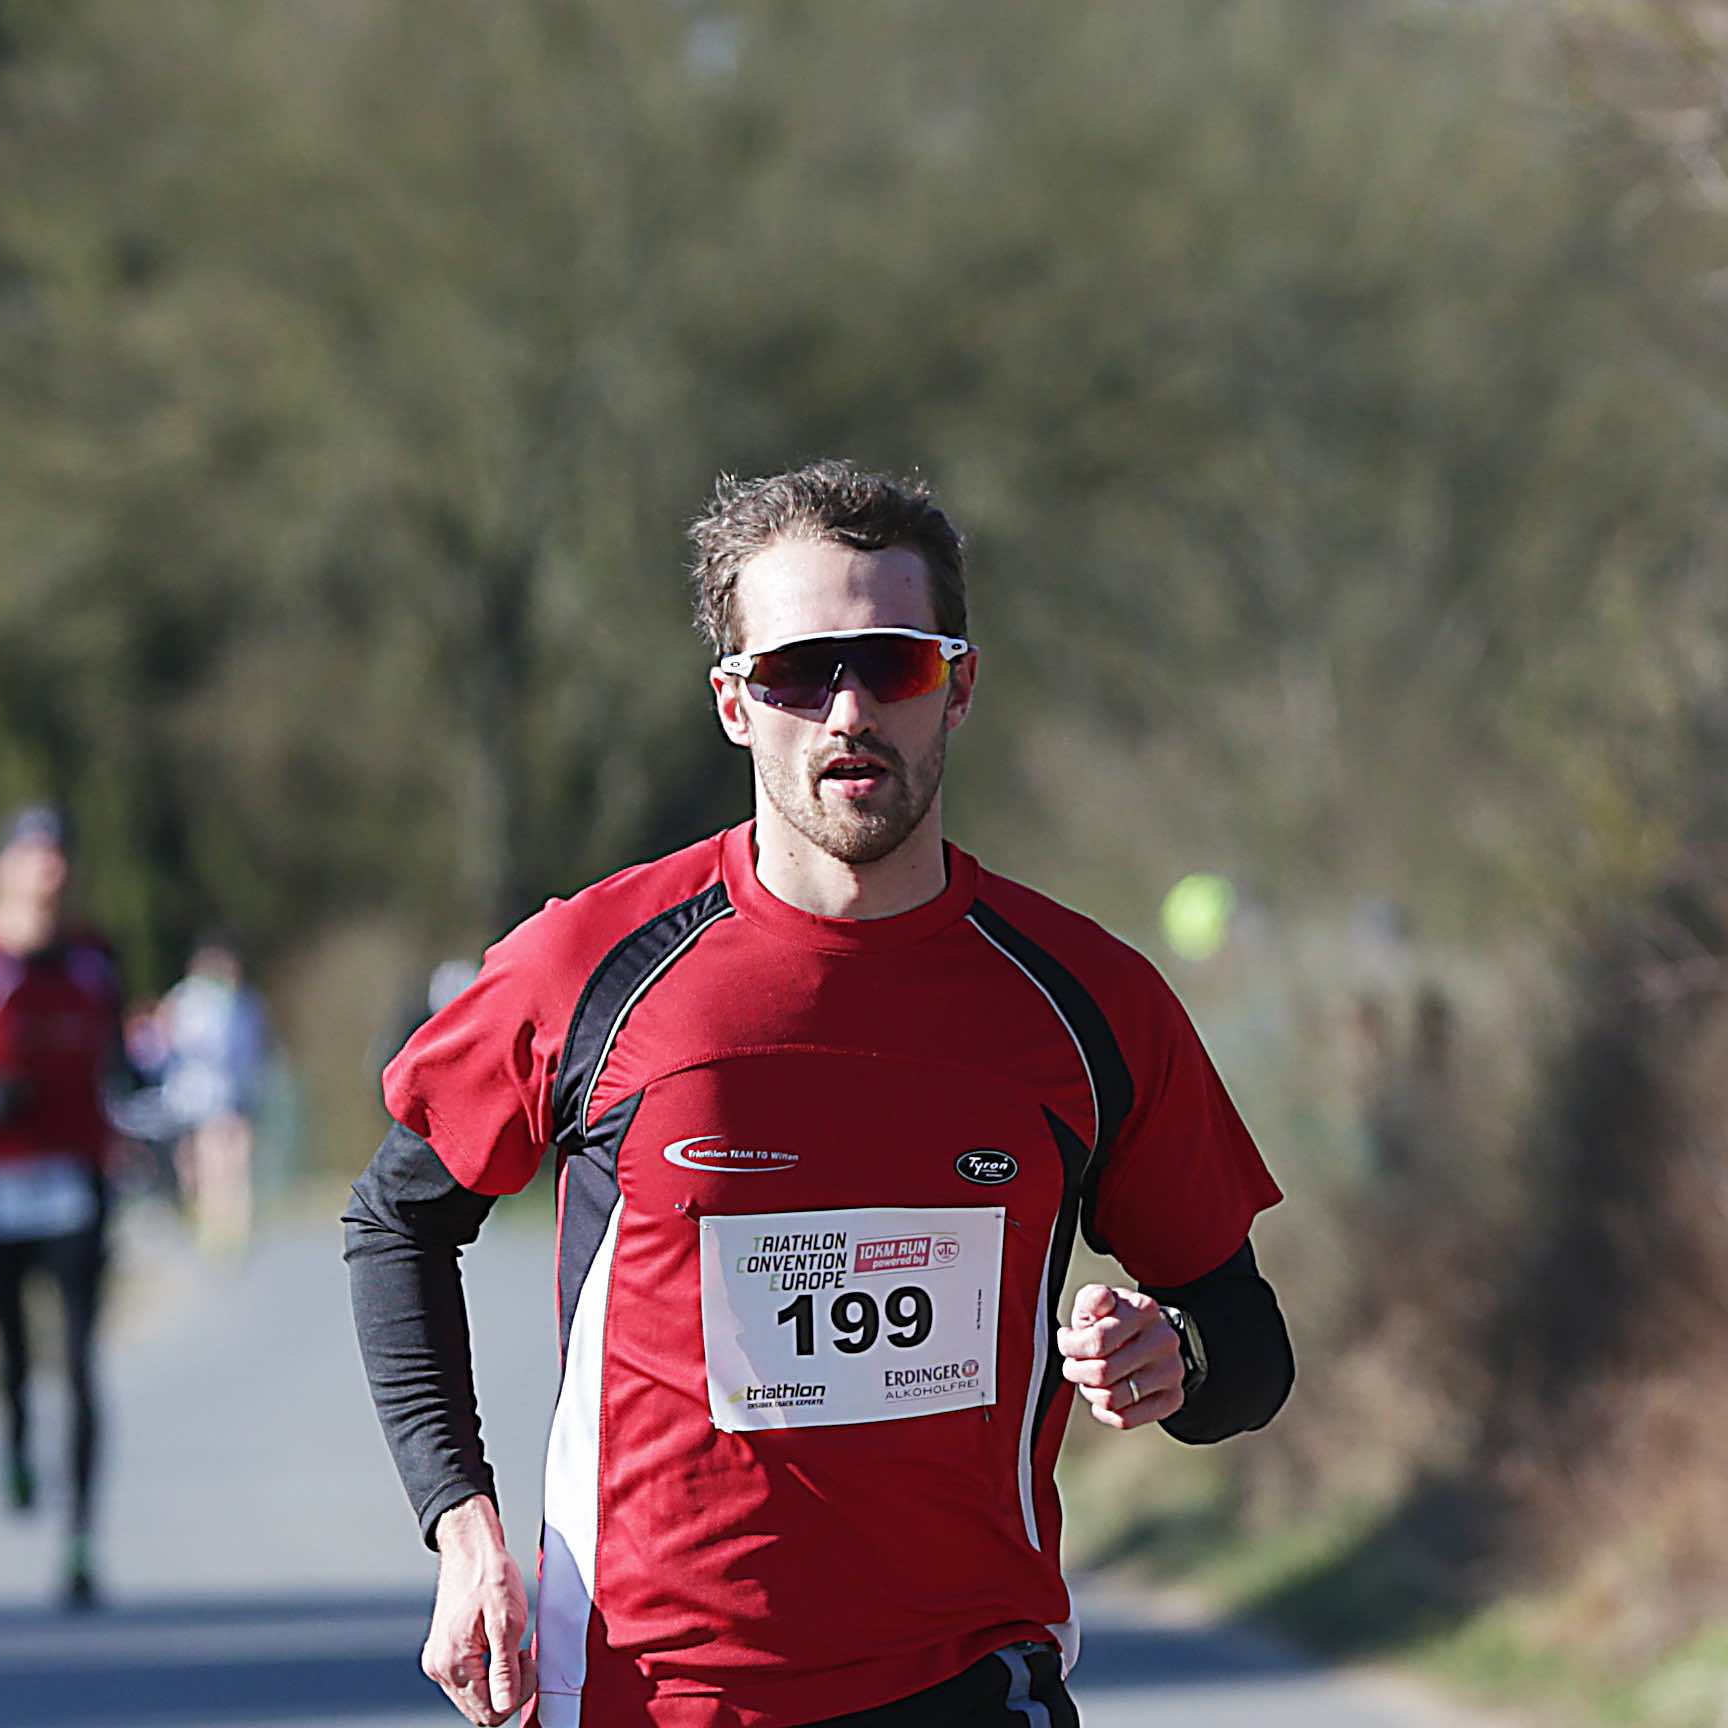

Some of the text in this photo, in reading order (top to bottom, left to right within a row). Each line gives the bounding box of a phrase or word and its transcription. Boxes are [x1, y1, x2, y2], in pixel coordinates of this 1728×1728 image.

[730, 1150, 754, 1159] TEAM
[969, 1156, 1008, 1176] Tyron
[752, 1232, 847, 1253] TRIATHLON
[898, 1240, 928, 1257] RUN
[736, 1252, 847, 1274] CONVENTION
[913, 1254, 926, 1266] by
[768, 1270, 847, 1292] EUROPE
[777, 1286, 933, 1356] 199
[884, 1363, 961, 1387] ERDINGER
[746, 1383, 826, 1401] triathlon
[884, 1379, 979, 1400] ALKOHOLFREI
